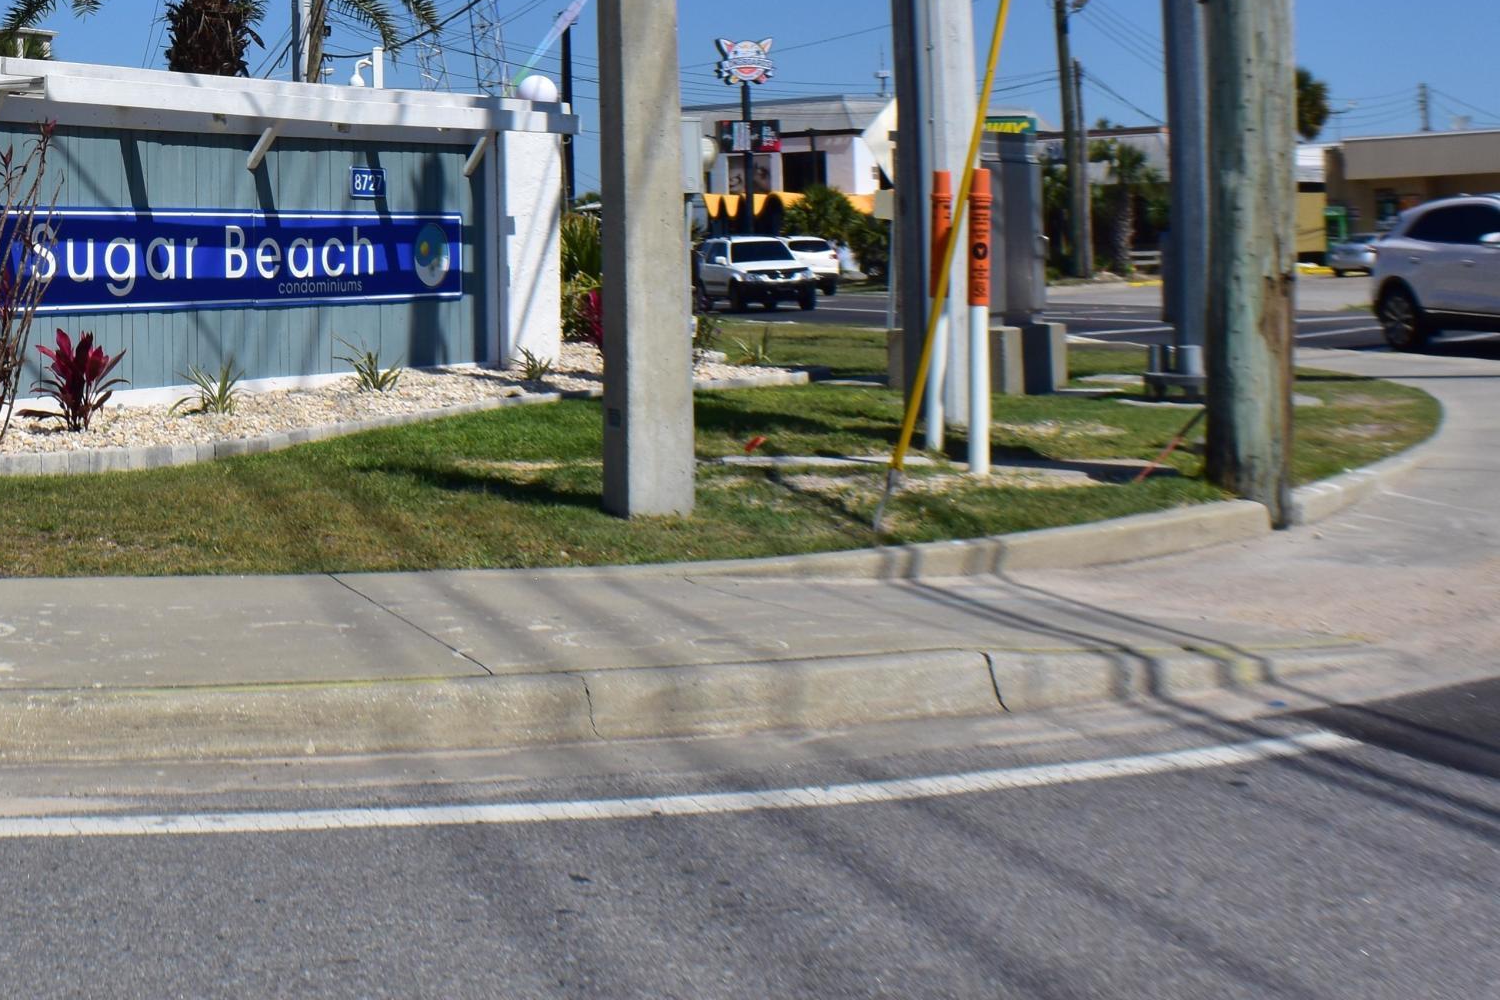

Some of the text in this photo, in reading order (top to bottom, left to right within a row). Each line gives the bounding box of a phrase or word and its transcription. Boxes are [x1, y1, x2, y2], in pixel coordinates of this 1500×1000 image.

[354, 173, 383, 191] 8727
[31, 223, 375, 297] Sugar Beach
[278, 279, 363, 295] condominiums
